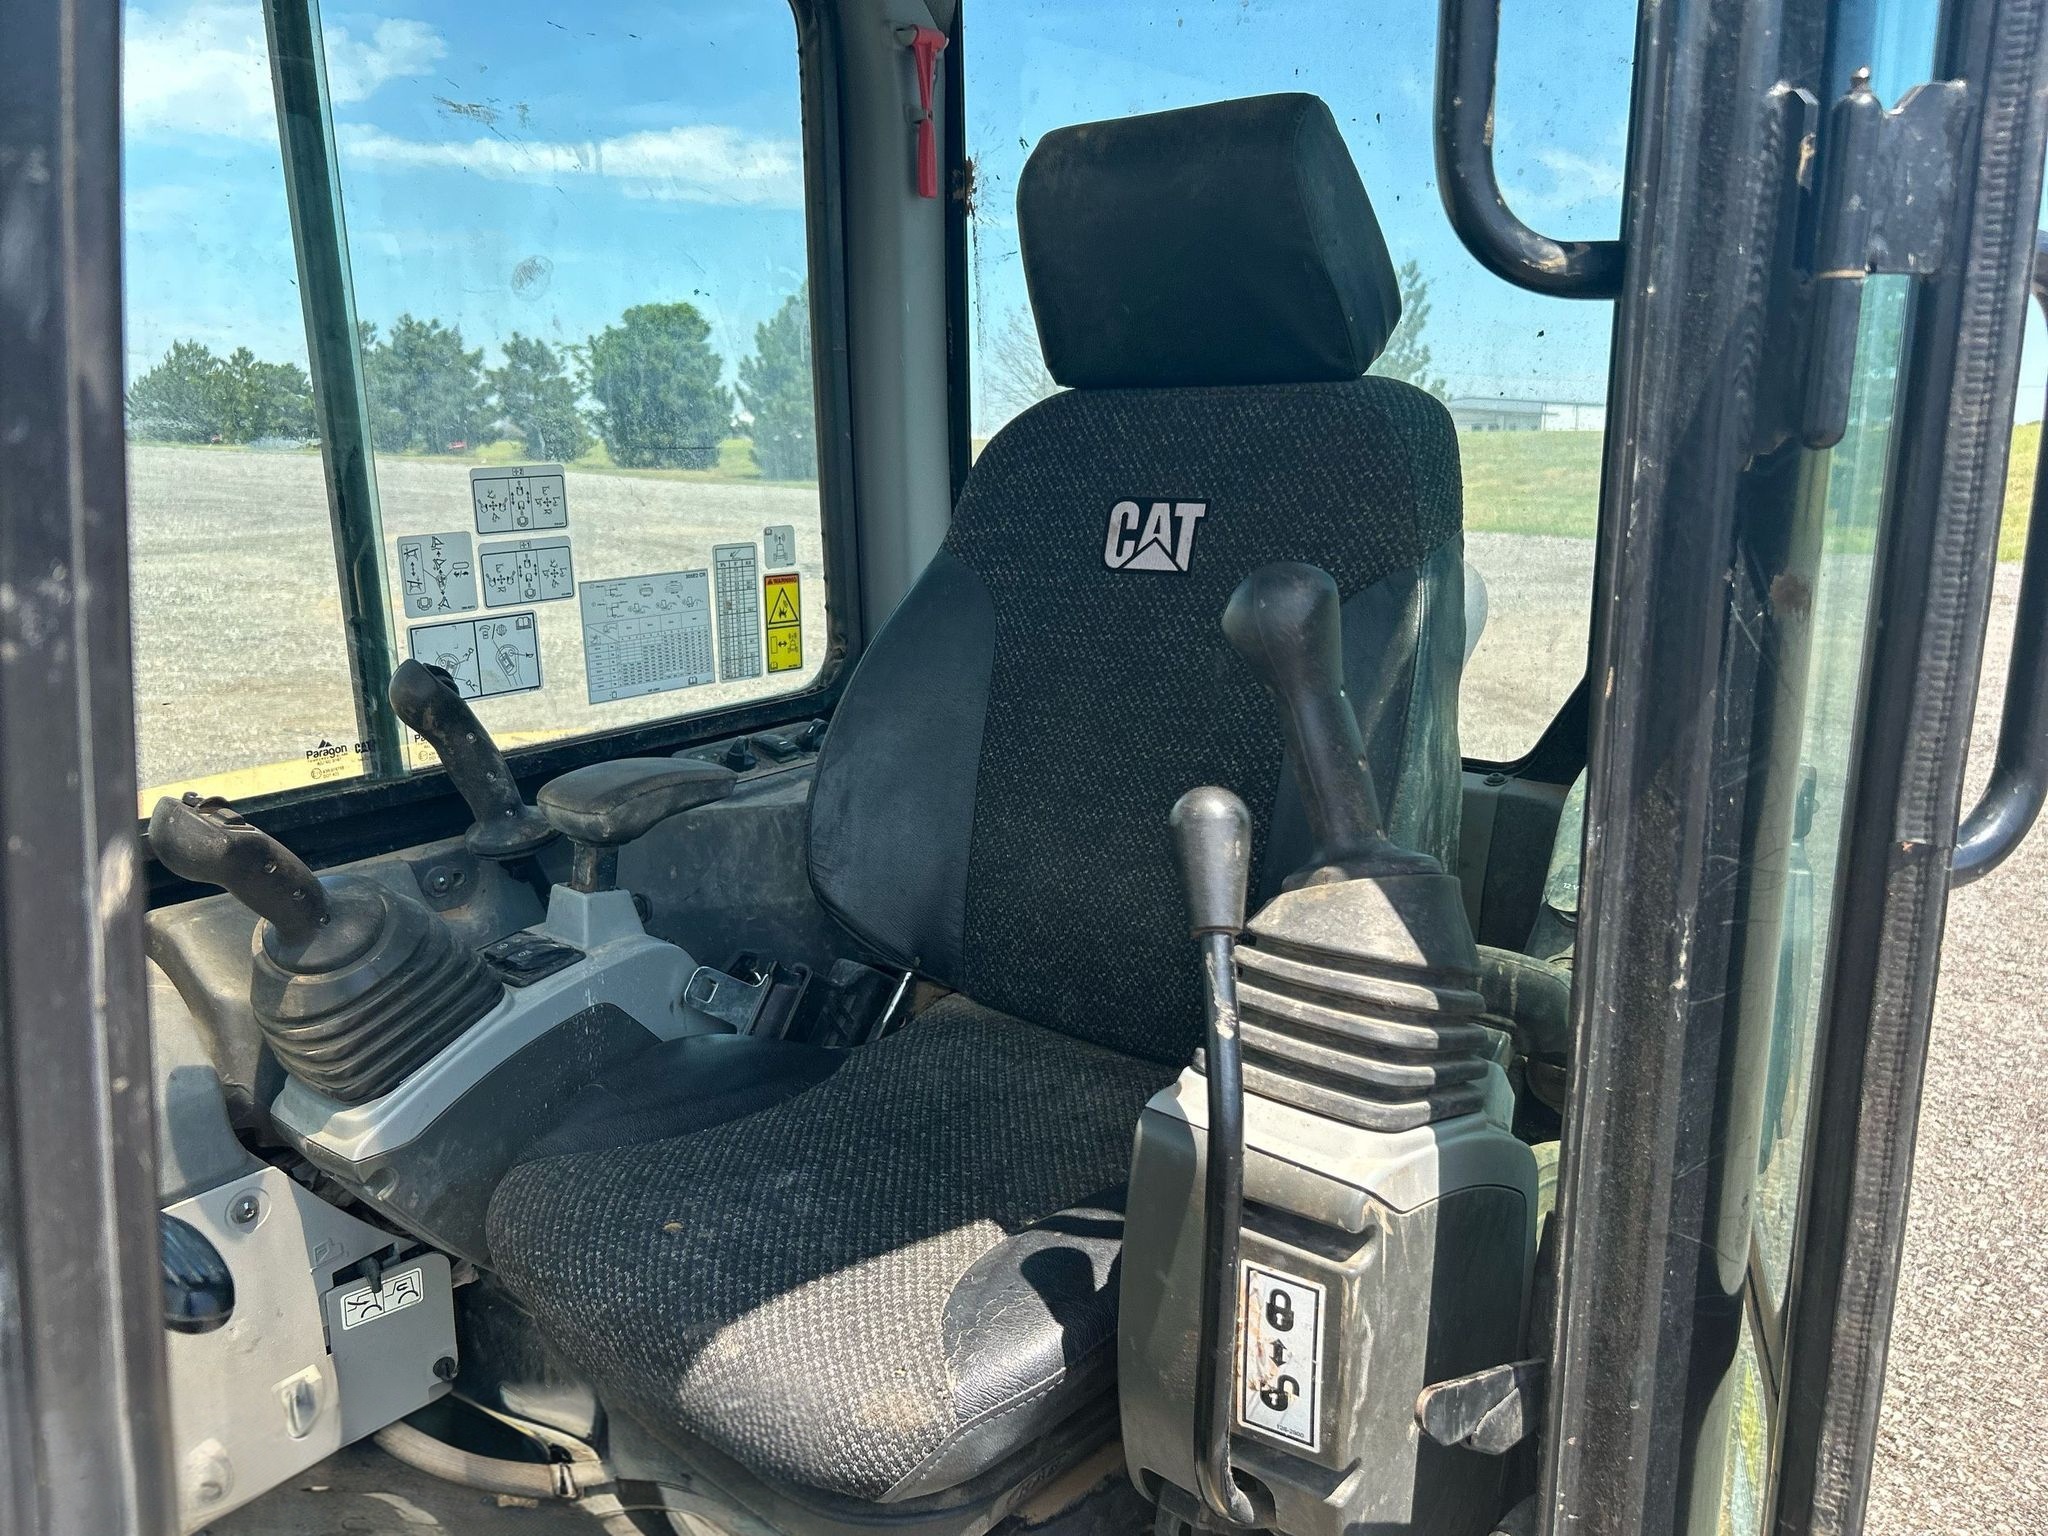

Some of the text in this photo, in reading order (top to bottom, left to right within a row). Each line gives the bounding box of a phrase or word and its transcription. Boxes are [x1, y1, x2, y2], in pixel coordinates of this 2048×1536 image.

[1104, 500, 1207, 572] CAT
[772, 576, 797, 585] WARNING
[306, 745, 348, 760] Paragon
